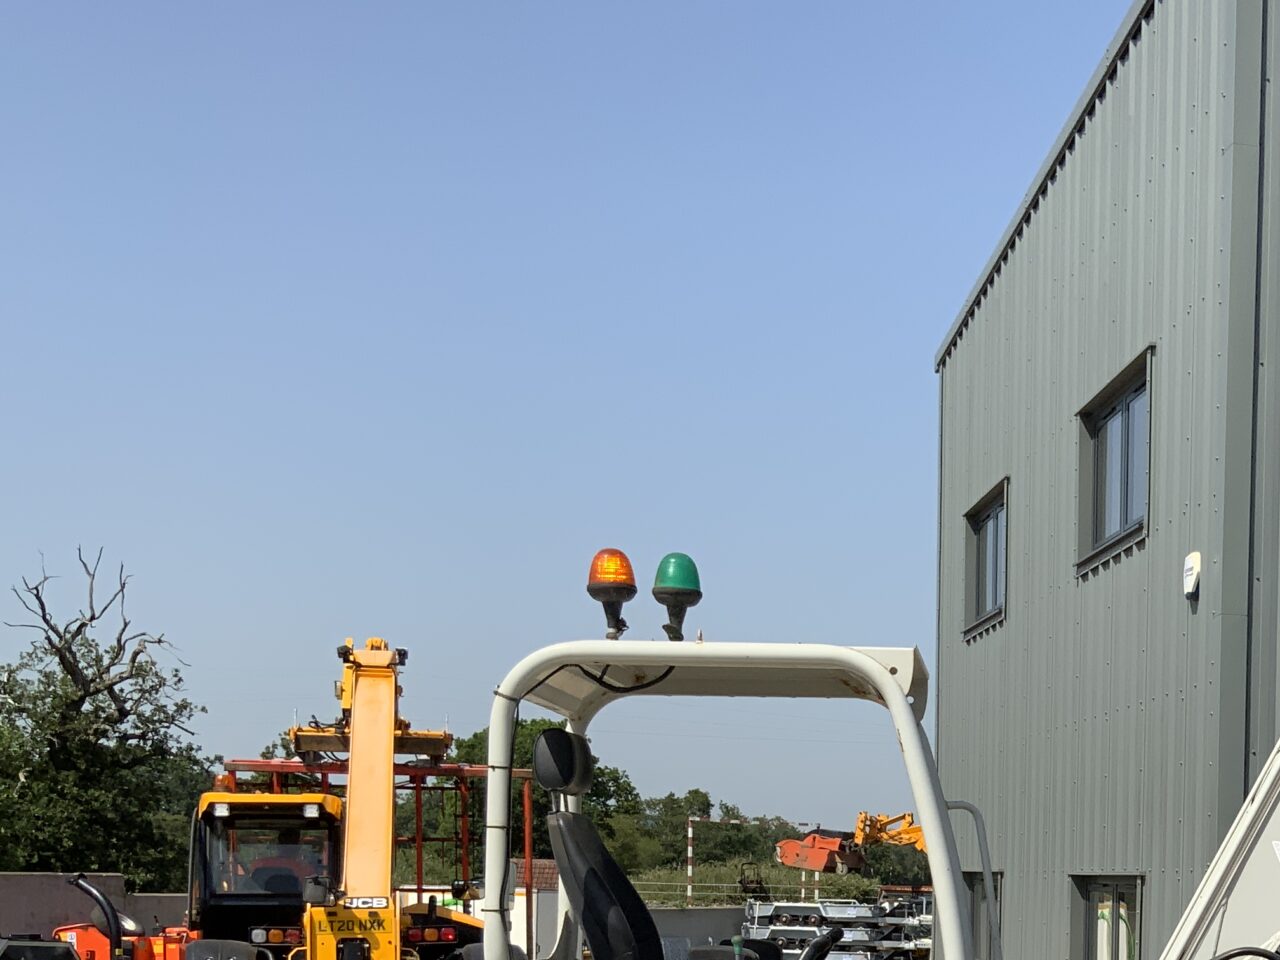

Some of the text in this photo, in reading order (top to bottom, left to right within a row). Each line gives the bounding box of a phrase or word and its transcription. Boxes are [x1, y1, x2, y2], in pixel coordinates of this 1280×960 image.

[345, 898, 387, 908] JCB
[319, 920, 386, 932] LT20 NXK
